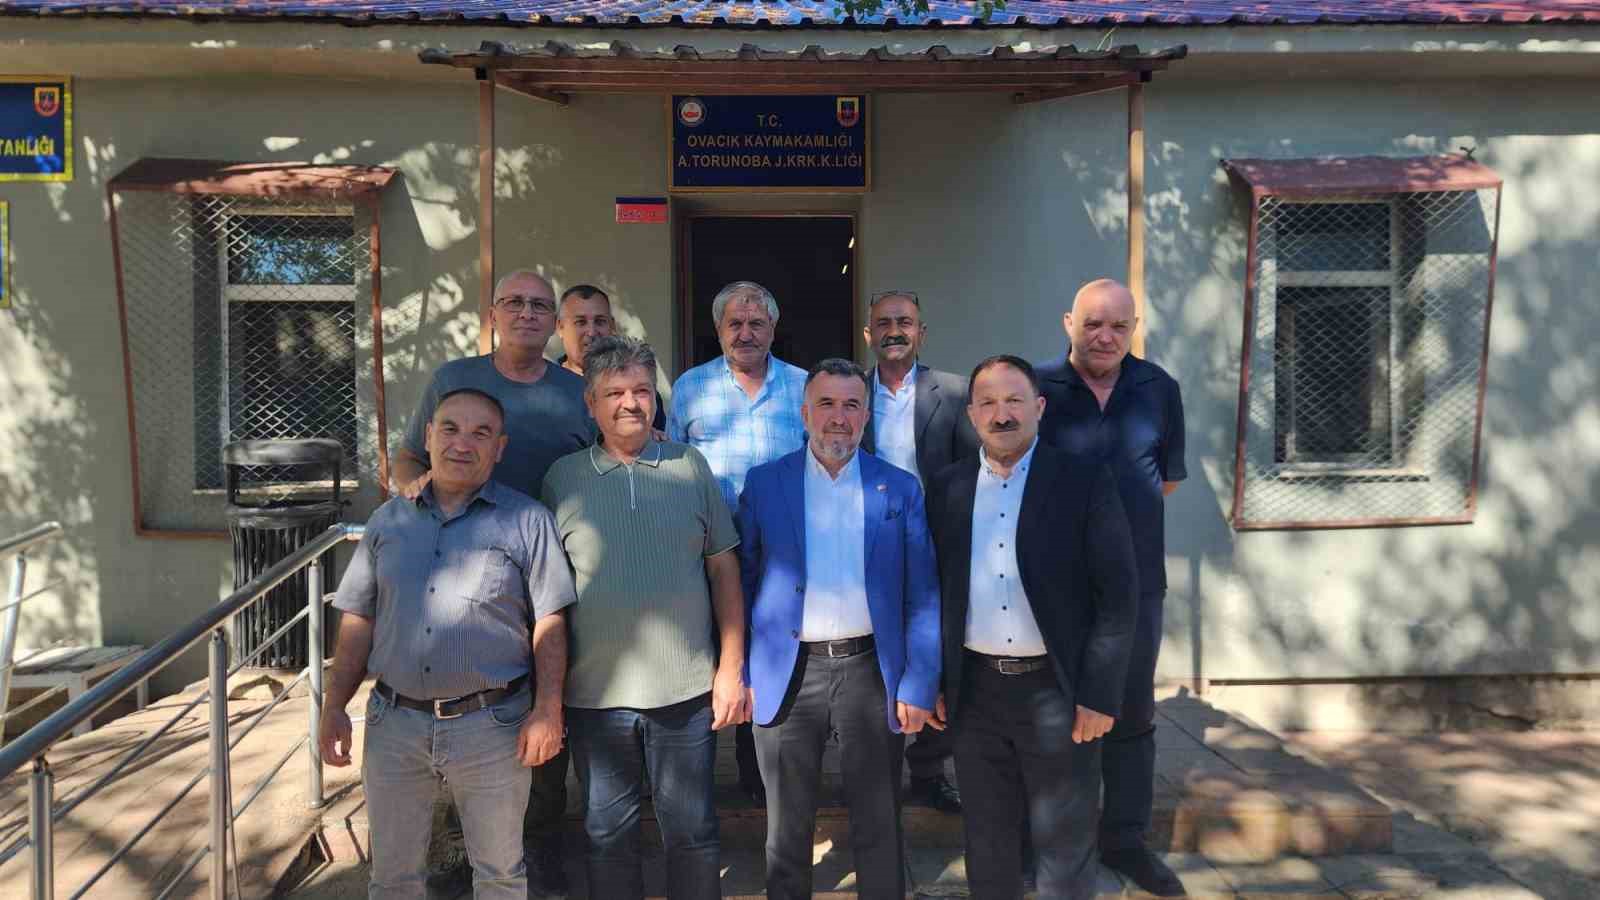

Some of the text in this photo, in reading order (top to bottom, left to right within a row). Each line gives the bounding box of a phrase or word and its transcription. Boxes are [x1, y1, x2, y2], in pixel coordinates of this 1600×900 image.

[757, 114, 783, 127] T.C.
[687, 132, 852, 148] OVACIK KAYMAKAMLIĞI
[678, 153, 862, 168] A.TORUNOBA J.KRK.K.LIĞI
